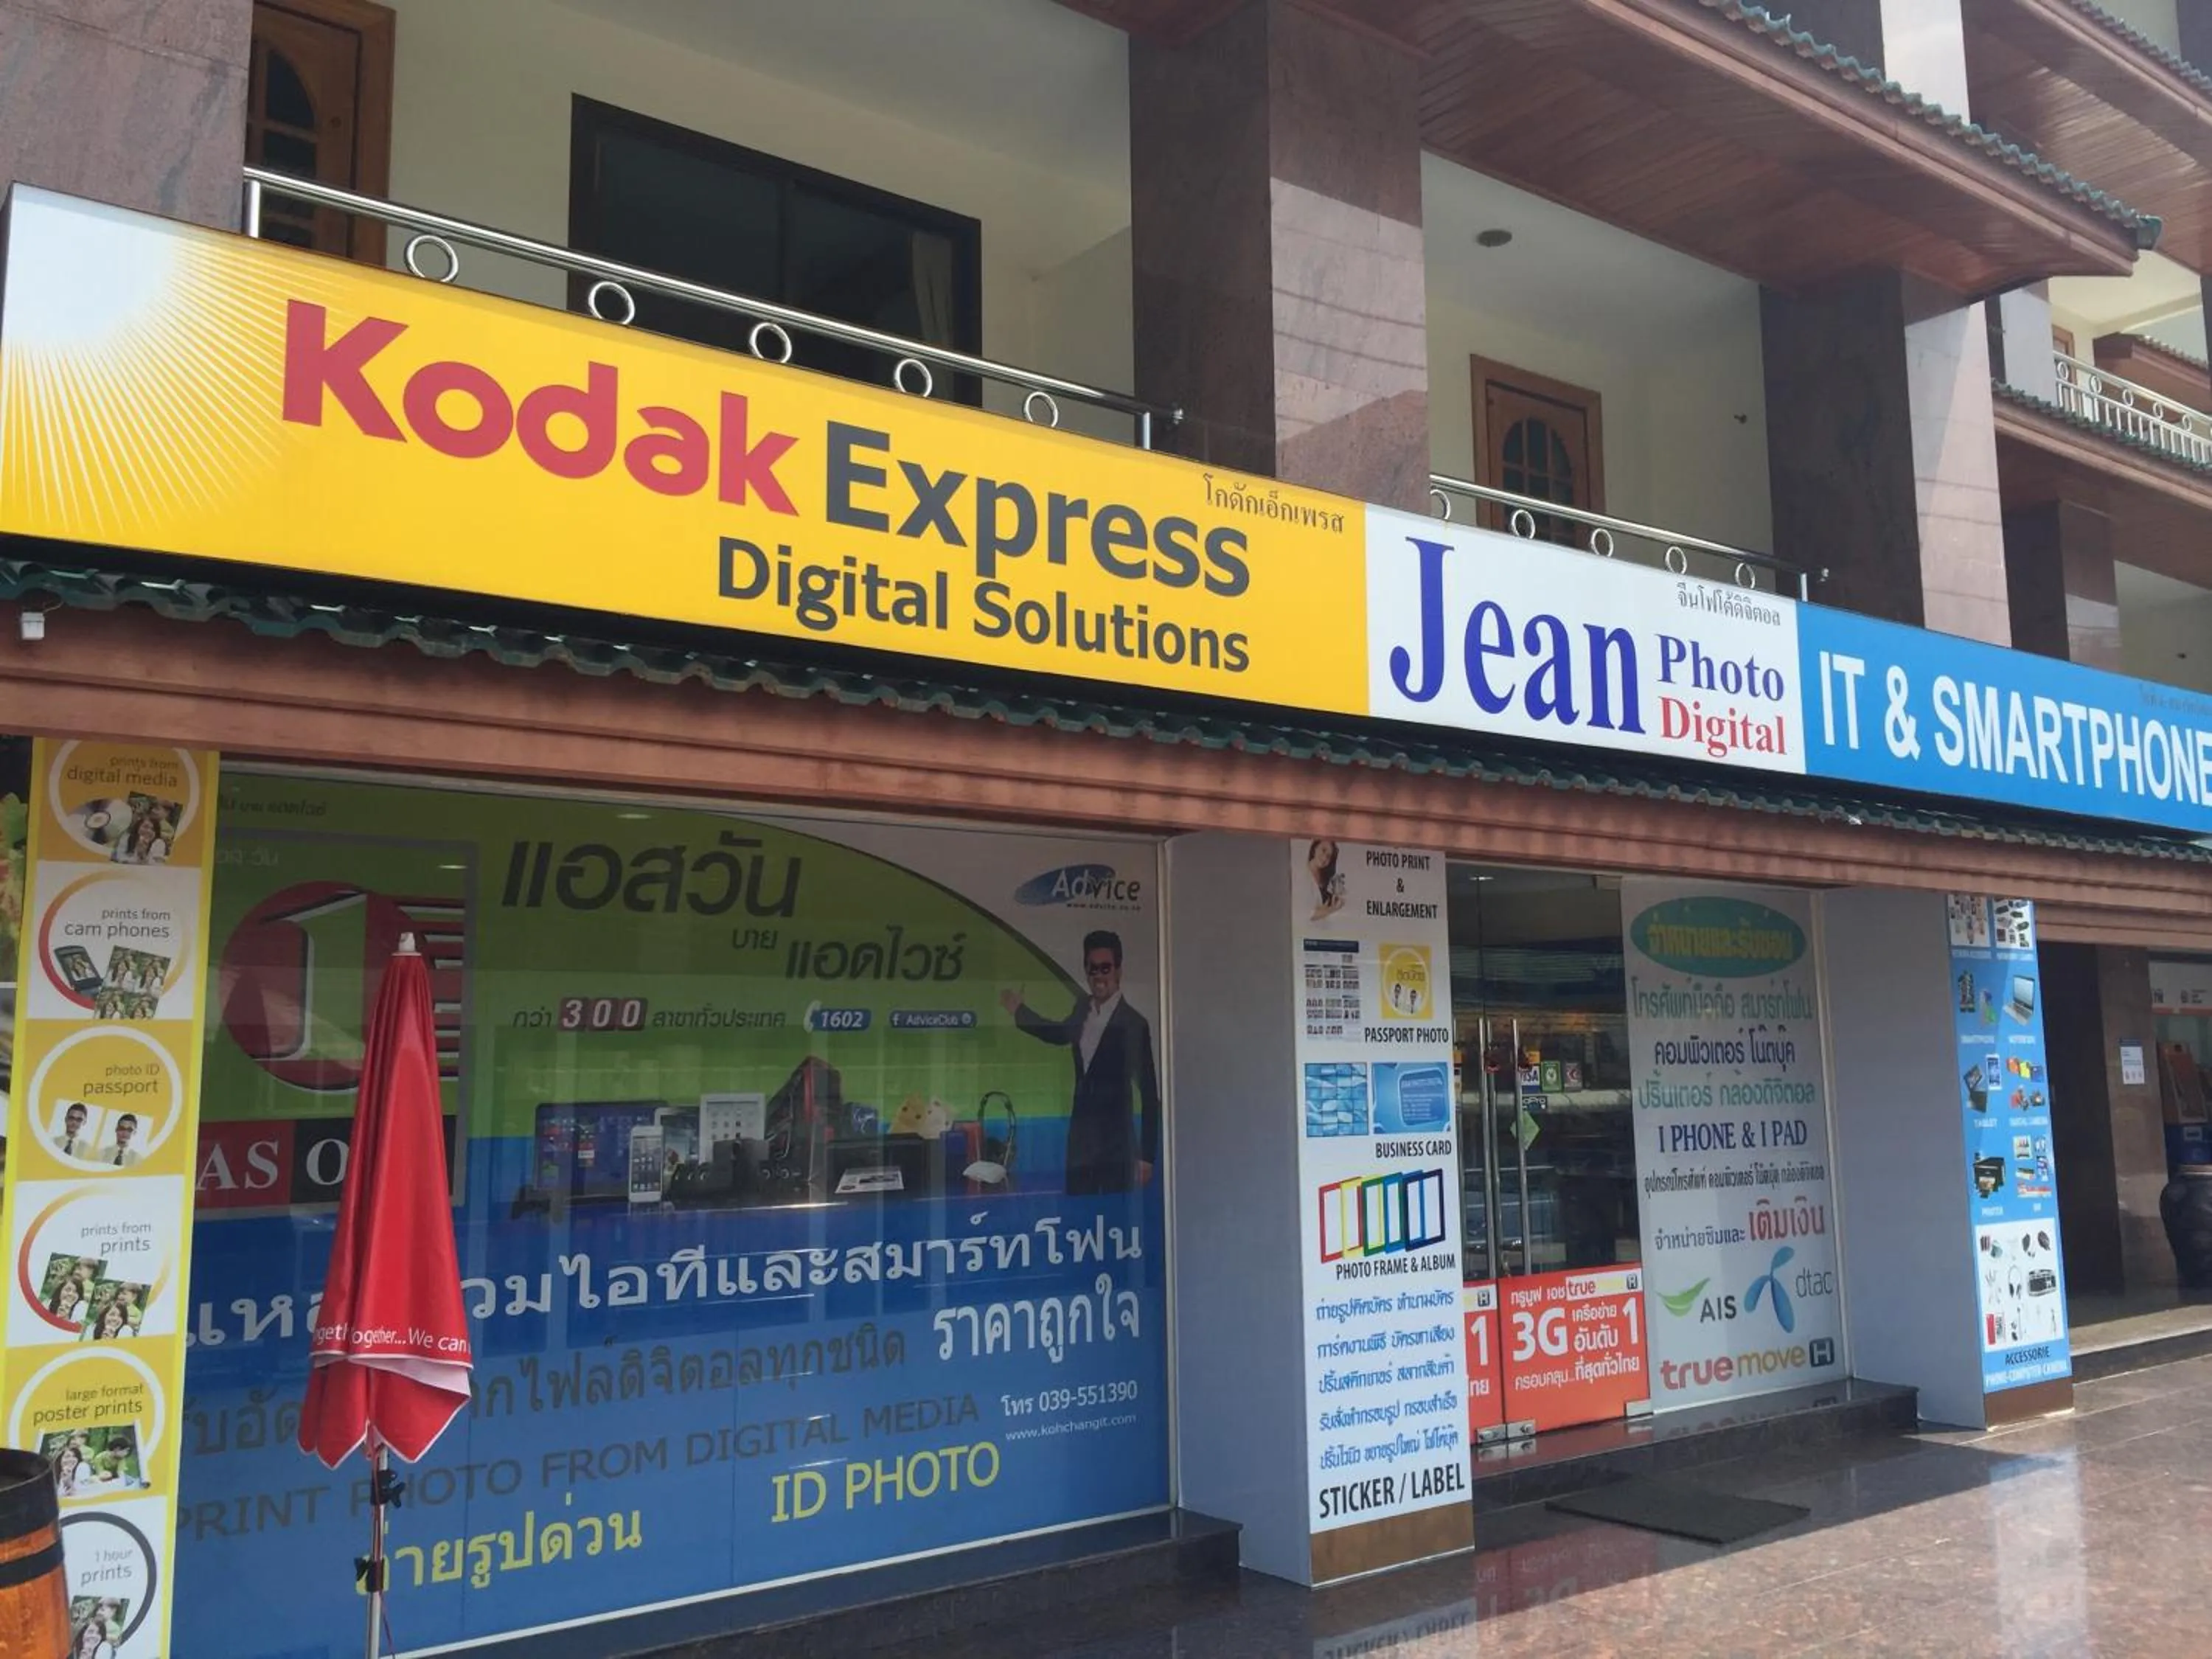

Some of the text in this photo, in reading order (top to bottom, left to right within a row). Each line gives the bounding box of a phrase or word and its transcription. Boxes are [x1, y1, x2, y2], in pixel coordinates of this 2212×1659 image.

[281, 299, 1251, 597] Kodak Express
[1203, 473, 1344, 533] โกดักเอ็กเพรส
[717, 536, 1251, 672] Digital Solutions
[1389, 536, 1646, 736] Jean
[1657, 634, 1785, 702] Photo
[1660, 696, 1787, 757] Digital
[1818, 651, 2212, 808] IT & SMARTPHONE
[67, 765, 178, 787] digital media
[109, 756, 179, 771] prints from
[502, 830, 802, 918] แอสวัน
[1366, 850, 1430, 871] PHOTO PRINT
[1051, 869, 1141, 901] Advice
[1397, 877, 1405, 894] &
[102, 908, 170, 921] prints from
[1366, 900, 1438, 919] ENLARGEMENT
[65, 922, 170, 939] cam phones
[732, 925, 966, 981] บาย แอดไวซ์
[512, 1006, 552, 1028] กว่า
[563, 999, 642, 1028] 300
[820, 1011, 864, 1027] 1602
[1365, 1026, 1450, 1044] PASSPORT PHOTO
[1655, 1028, 1745, 1065] คอมพิวเตอร์
[105, 1063, 160, 1077] photo ID
[1521, 1069, 1539, 1082] ISA
[83, 1079, 158, 1097] passport
[1375, 1140, 1452, 1159] BUSINESS CARD
[1659, 1120, 1808, 1153] I PHONE & I PAD
[195, 1140, 279, 1190] AS
[80, 1222, 151, 1238] prints from
[1655, 1195, 1826, 1251] จำหน่ายซิมและ เติมเงิน
[100, 1237, 150, 1256] prints
[1336, 1254, 1455, 1281] PHOTO FRAME & ALBUM
[1568, 1281, 1596, 1296] true
[1795, 1267, 1833, 1299] dtac
[933, 1273, 1139, 1363] ราคาถูกใจ
[1700, 1295, 1737, 1324] AIS
[408, 1327, 434, 1348] We
[437, 1336, 467, 1352] can
[1471, 1315, 1489, 1366] 1
[1513, 1298, 1638, 1361] 3G เครือข่าย 1
[1573, 1324, 1618, 1352] อันดับ
[66, 1382, 143, 1402] large format
[1001, 1380, 1138, 1416] โทร 039-551390
[33, 1399, 142, 1426] poster prints
[1005, 1414, 1136, 1441] www.kohchangit.com
[349, 1459, 523, 1518] POTO
[543, 1439, 667, 1488] FROM
[686, 1413, 849, 1466] DIGITAL
[863, 1394, 980, 1439] MEDIA
[771, 1441, 1000, 1523] ID PHOTO
[1319, 1463, 1465, 1519] STICKER / LABEL
[105, 1549, 133, 1562] hour
[80, 1565, 133, 1586] prints
